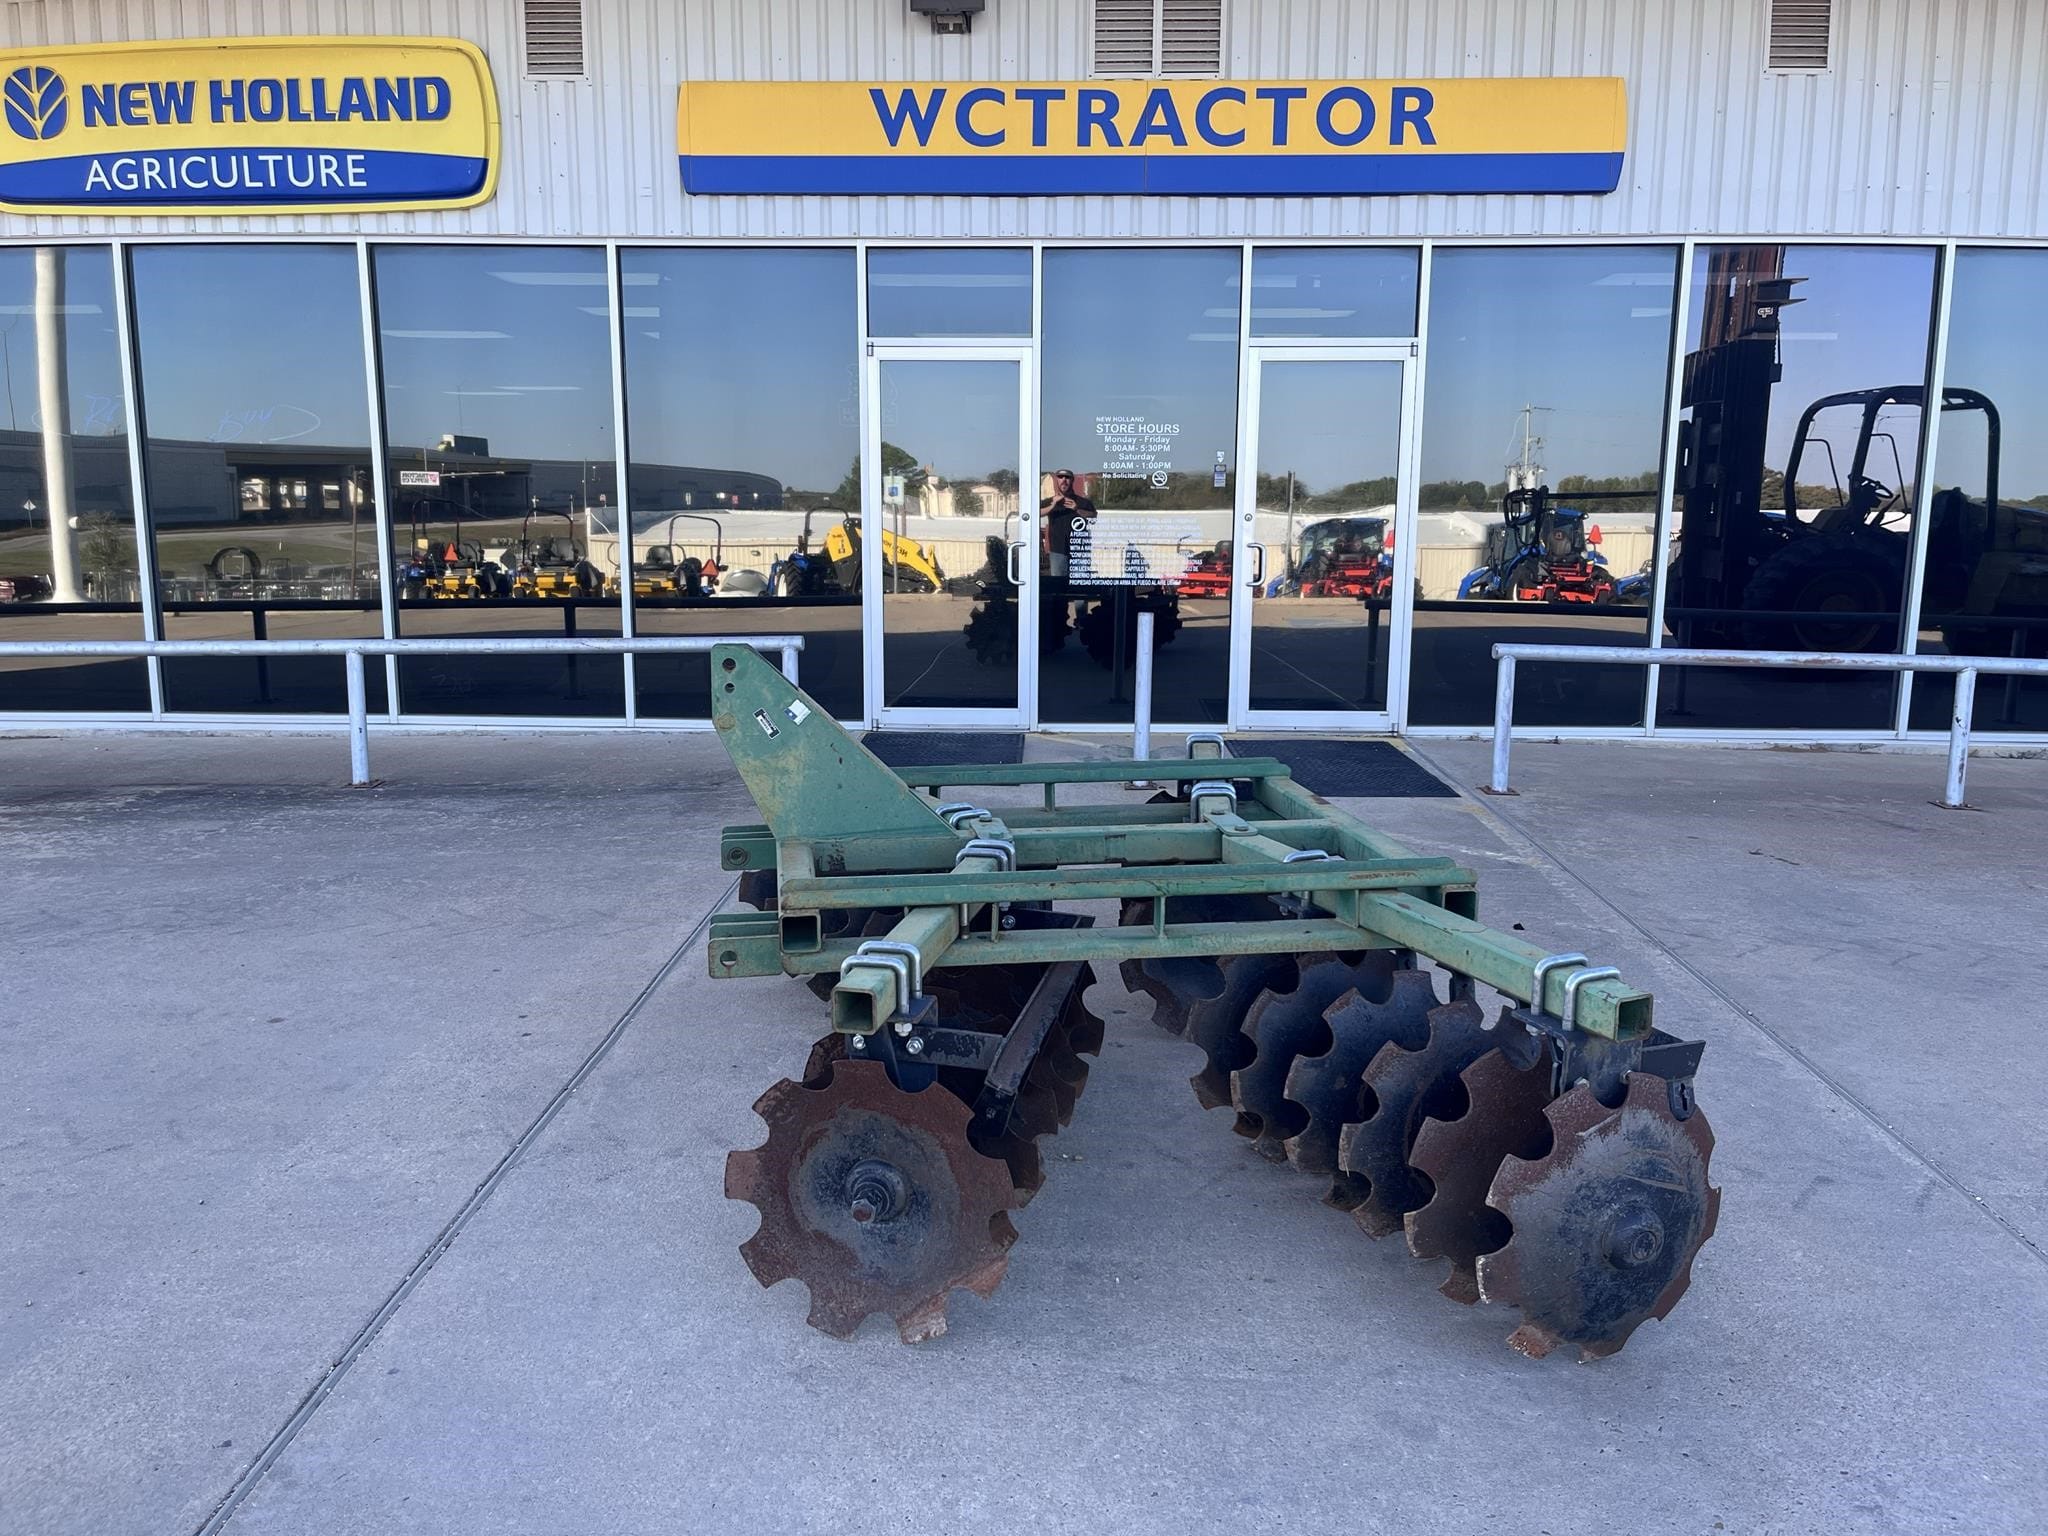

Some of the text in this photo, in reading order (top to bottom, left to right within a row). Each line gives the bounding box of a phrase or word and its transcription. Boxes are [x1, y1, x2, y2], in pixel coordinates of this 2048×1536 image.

[82, 76, 452, 127] NEW HOLLAND
[868, 86, 1437, 148] WCTRACTOR
[84, 153, 368, 192] AGRICULTURE
[1095, 423, 1180, 434] STORE HOURS
[1104, 435, 1137, 444] Monday
[1144, 435, 1171, 444] Friday
[1140, 444, 1171, 452] 5:30PM
[1118, 452, 1156, 461] Saturday
[1103, 461, 1134, 469] 8:00AM
[1142, 461, 1172, 469] 1:00PM
